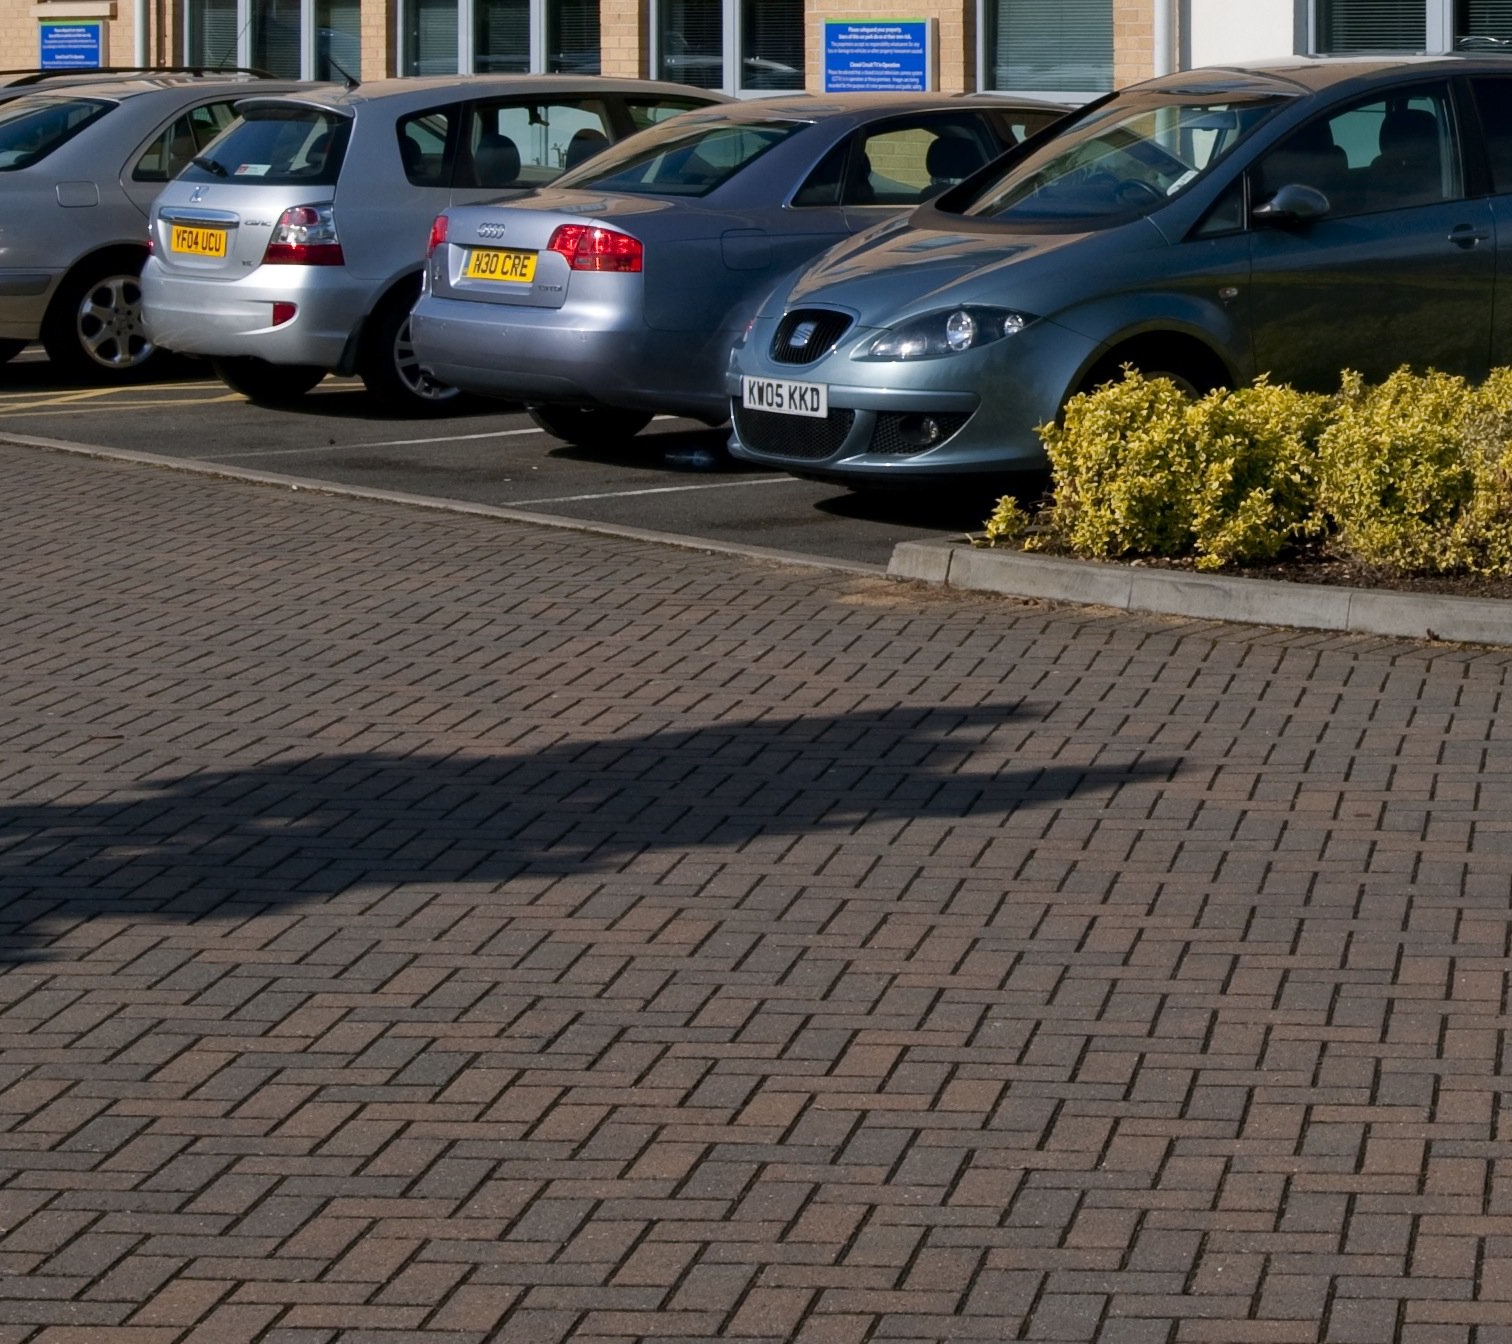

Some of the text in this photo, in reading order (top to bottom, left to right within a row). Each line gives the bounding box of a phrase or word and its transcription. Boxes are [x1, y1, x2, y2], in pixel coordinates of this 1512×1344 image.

[176, 229, 222, 252] YF04 UCU
[500, 255, 531, 278] CRE
[748, 379, 820, 412] KW05 KKD
